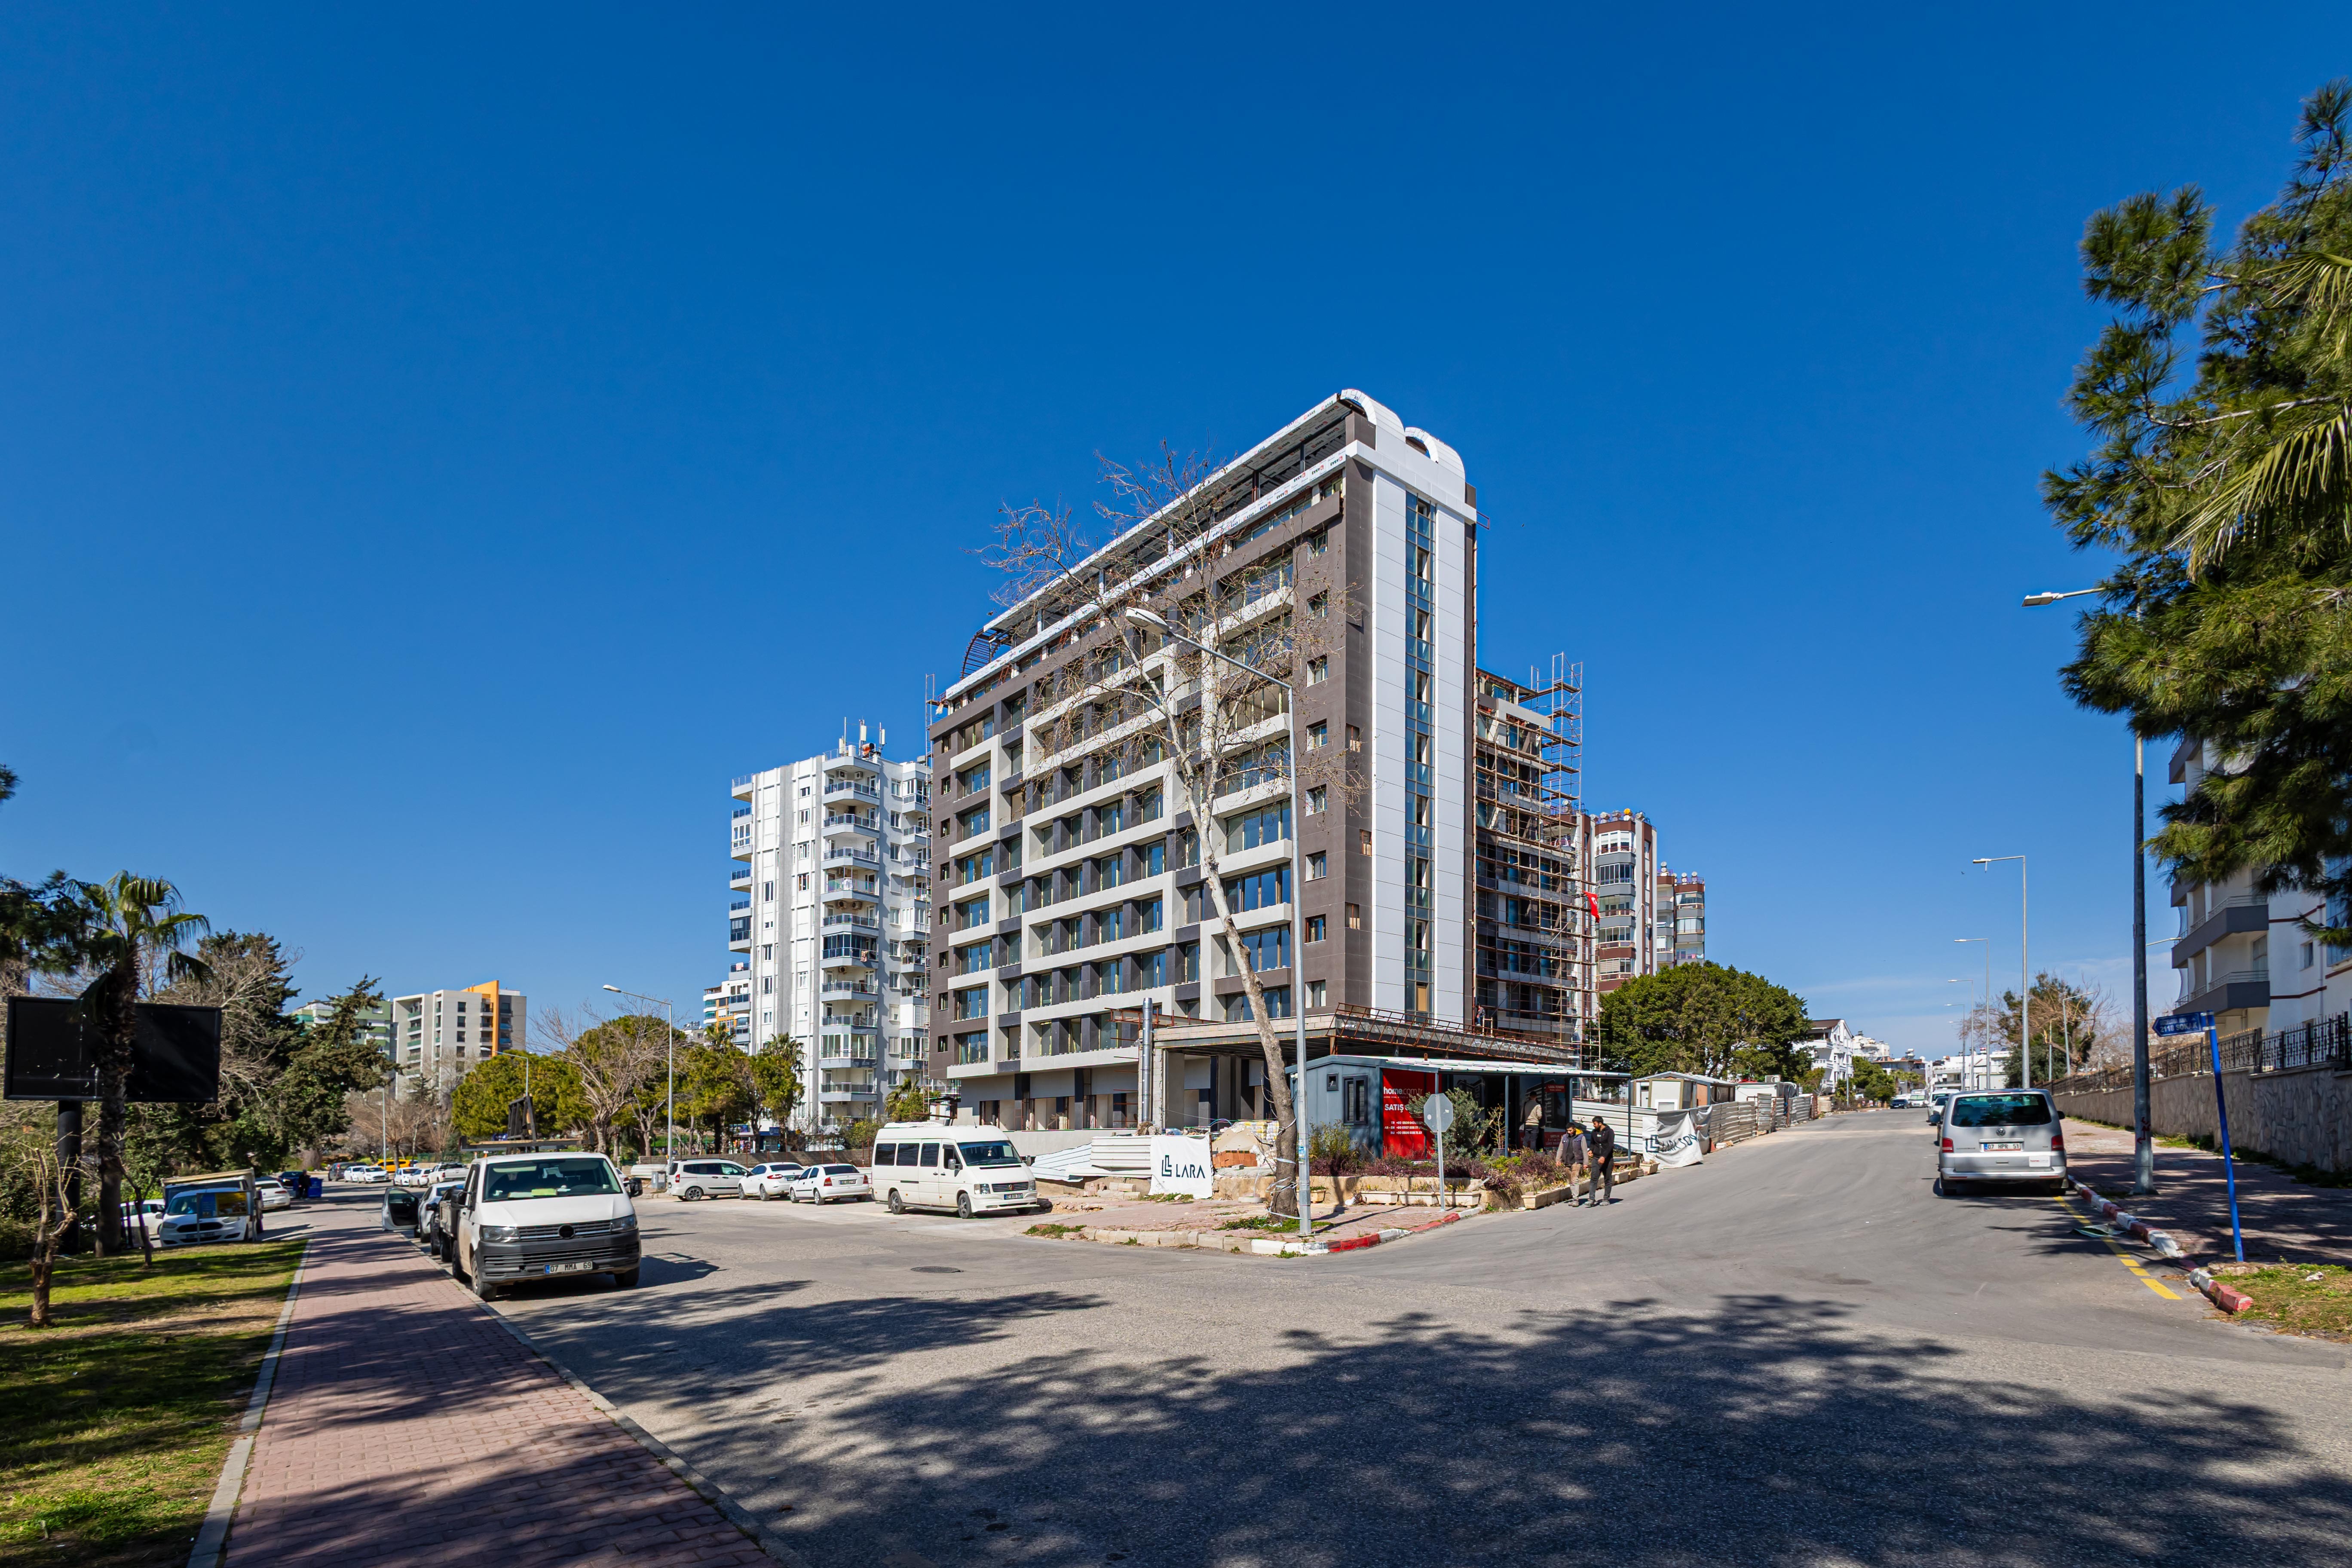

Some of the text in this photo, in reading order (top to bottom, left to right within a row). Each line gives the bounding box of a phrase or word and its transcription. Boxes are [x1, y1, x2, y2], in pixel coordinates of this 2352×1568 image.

[2175, 1022, 2198, 1031] SOKAK
[1384, 1086, 1423, 1094] home.com.tr
[1384, 1104, 1404, 1113] SATIŞ
[1176, 1164, 1206, 1179] LARA
